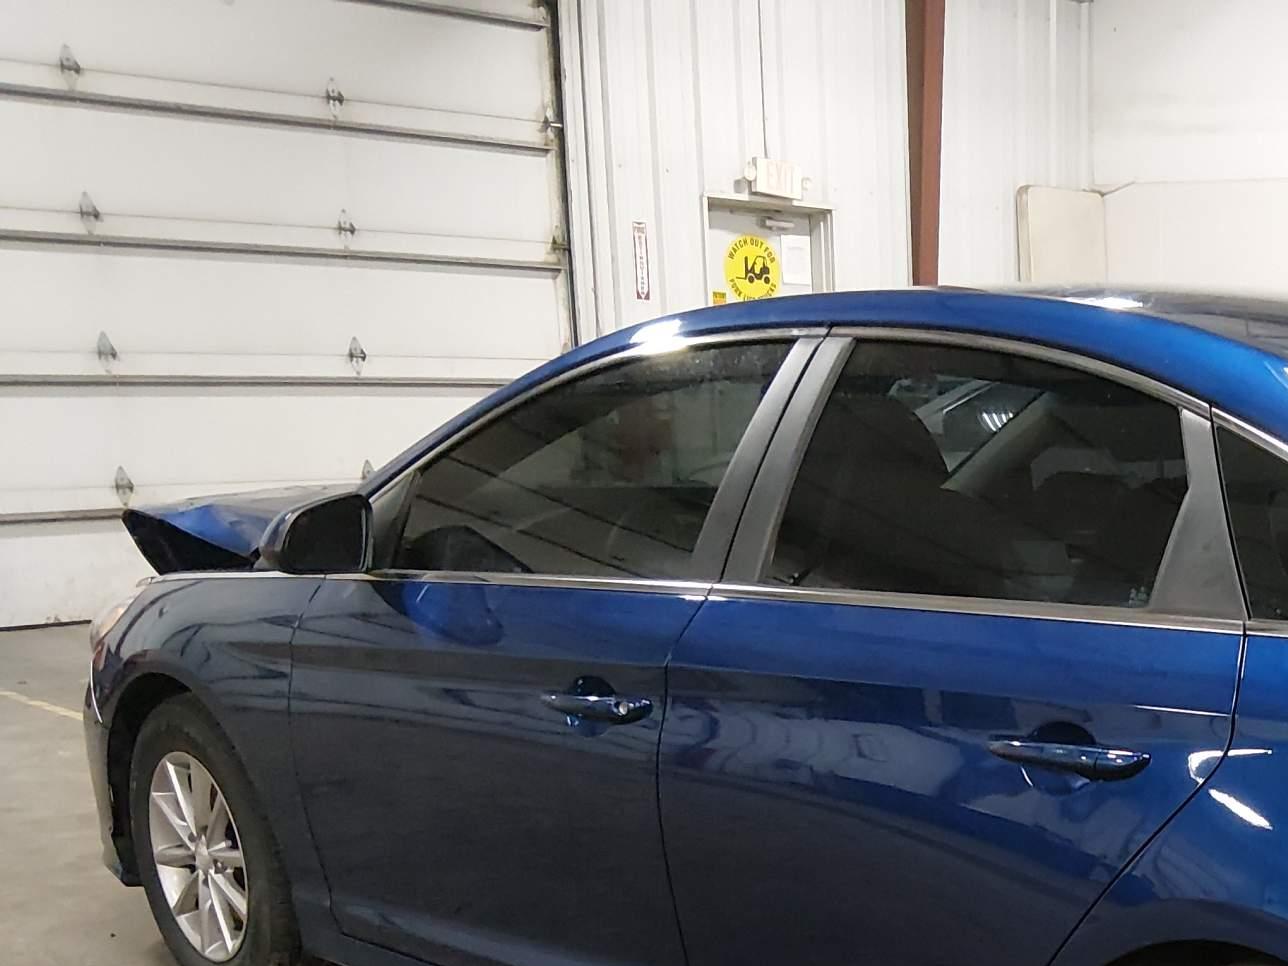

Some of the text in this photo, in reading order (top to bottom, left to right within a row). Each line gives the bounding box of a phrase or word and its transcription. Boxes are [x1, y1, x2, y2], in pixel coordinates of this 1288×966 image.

[728, 238, 776, 263] WATCH OUT FOR
[729, 278, 743, 297] FORK
